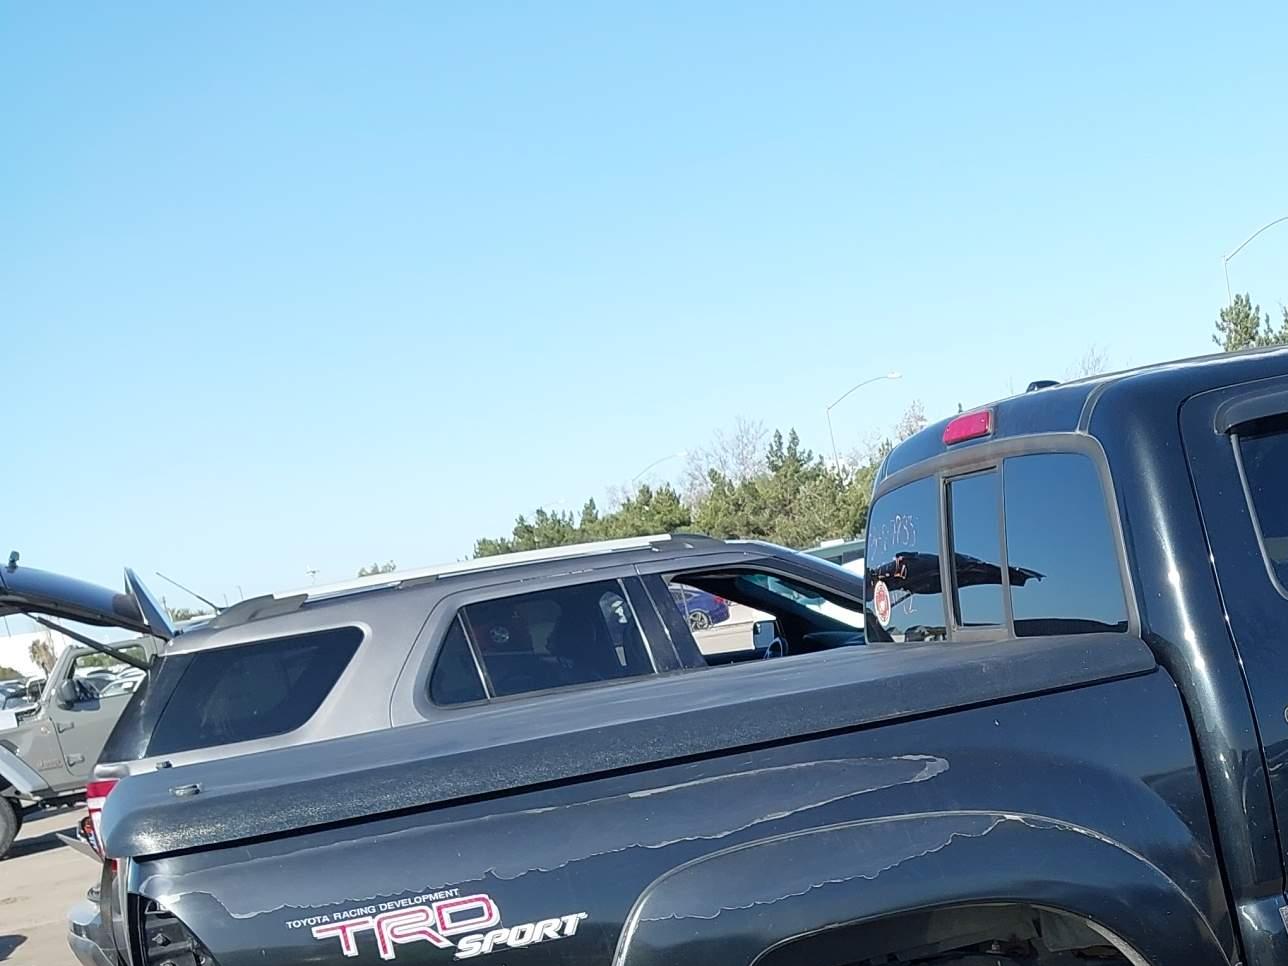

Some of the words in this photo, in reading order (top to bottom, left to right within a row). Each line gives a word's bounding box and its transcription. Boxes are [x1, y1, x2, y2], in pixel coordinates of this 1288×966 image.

[286, 914, 331, 930] TOYOTA
[333, 904, 378, 921] RACING
[379, 887, 461, 912] DEVELOPMENT
[311, 893, 501, 961] TRD
[453, 911, 590, 961] SPORT
